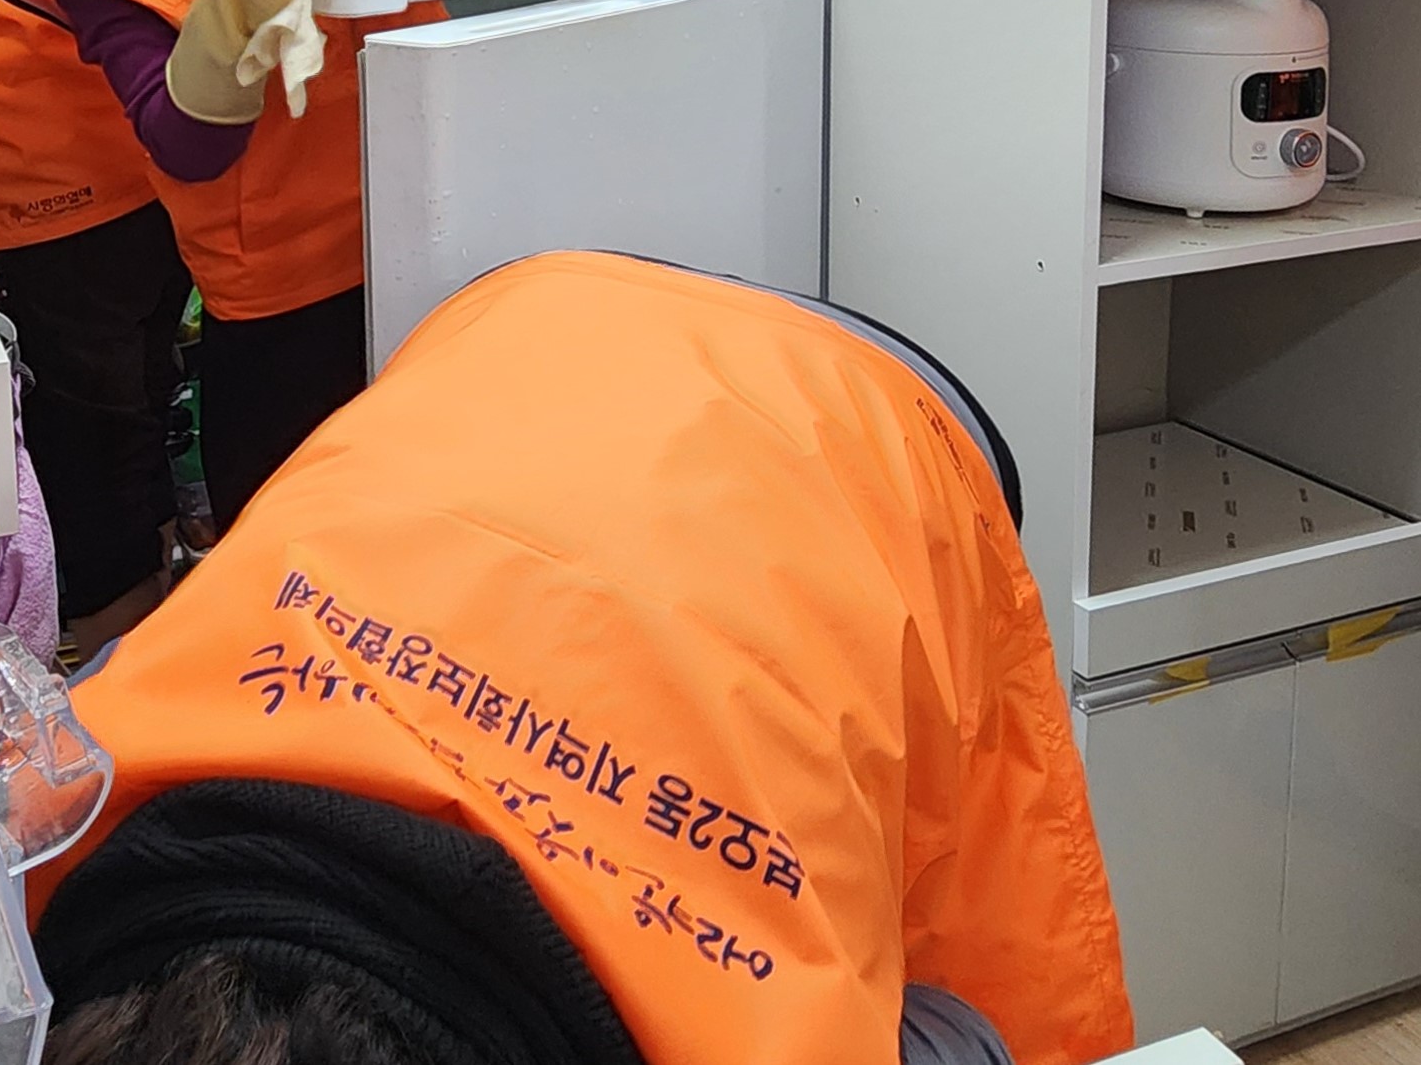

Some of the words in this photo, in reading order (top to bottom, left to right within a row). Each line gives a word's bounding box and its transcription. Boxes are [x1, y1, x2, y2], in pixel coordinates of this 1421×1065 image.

[274, 571, 637, 806] 지역사회보장협의체
[644, 773, 805, 901] 본오2동
[625, 864, 774, 981] 어려운
